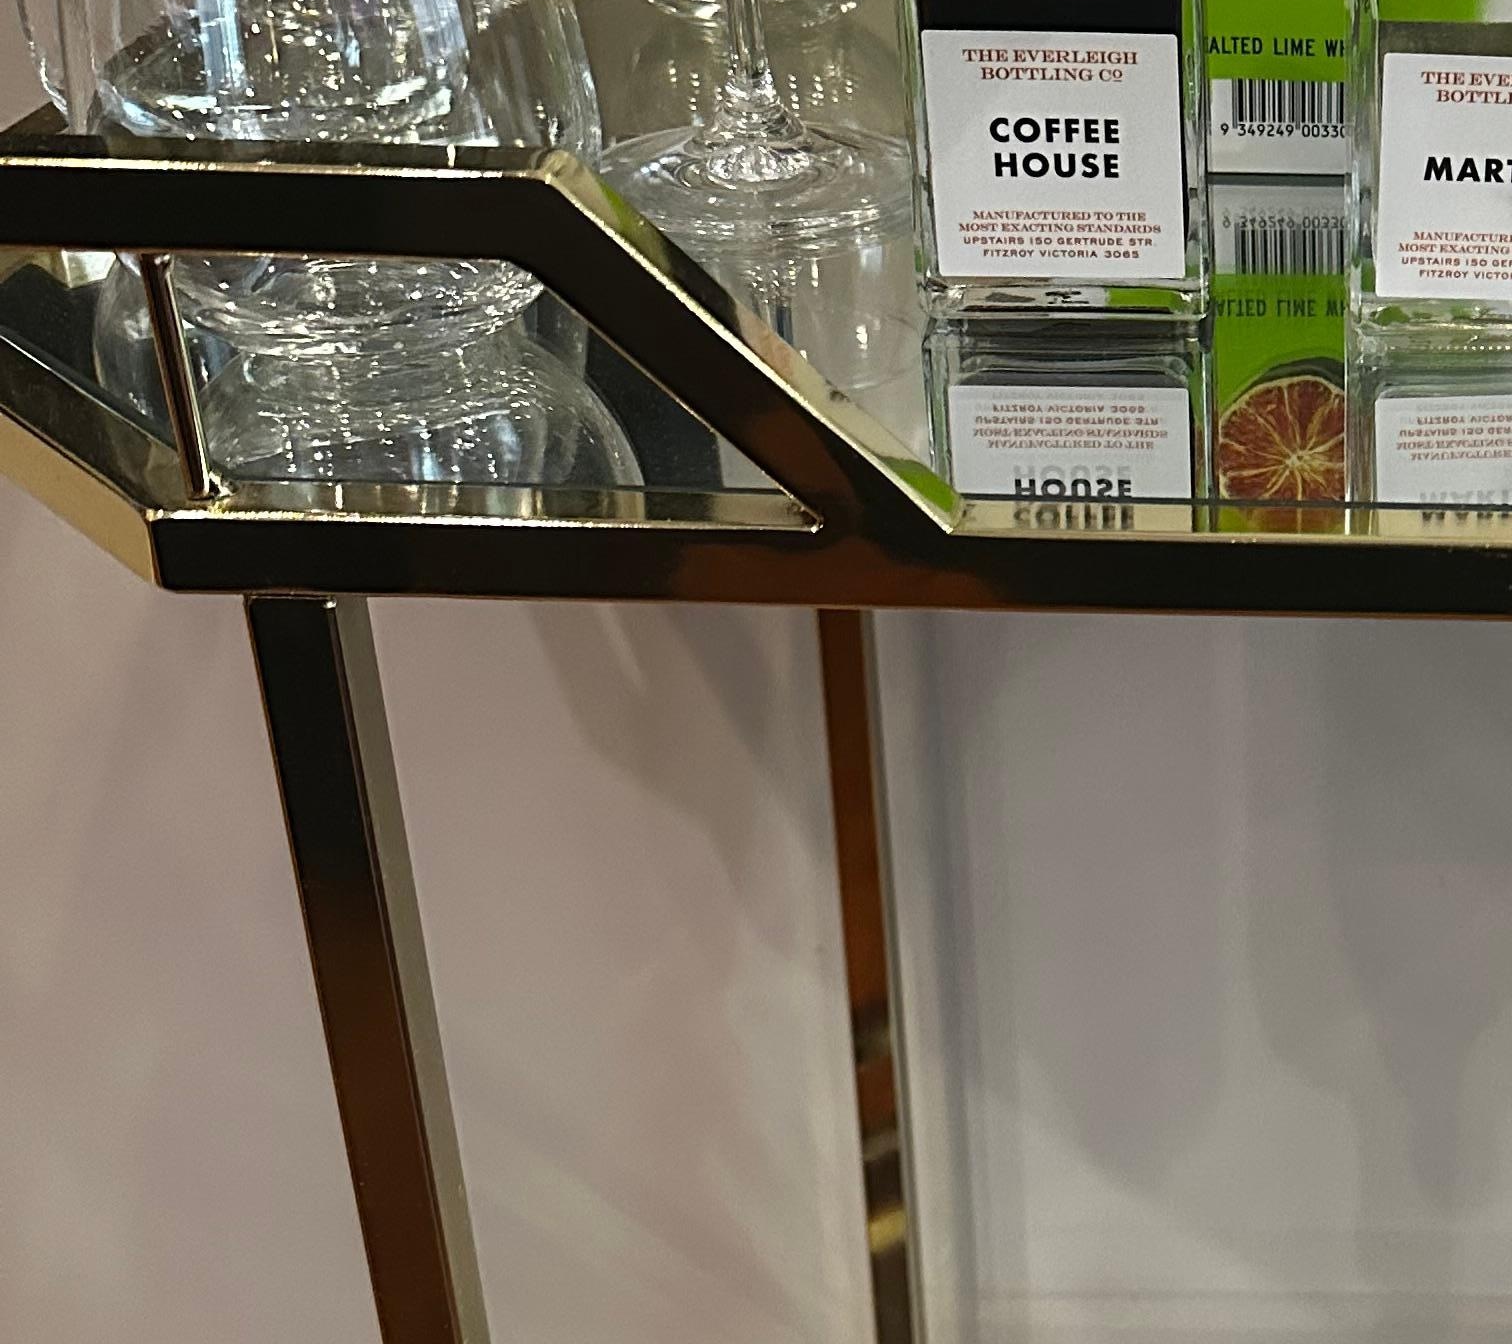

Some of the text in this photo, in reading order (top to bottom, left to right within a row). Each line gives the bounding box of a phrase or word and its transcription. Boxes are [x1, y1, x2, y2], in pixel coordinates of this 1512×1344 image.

[1273, 38, 1316, 57] LIME
[962, 49, 1138, 65] THE EVERLEIGH
[981, 67, 1093, 82] BOTTLING
[1421, 71, 1465, 86] THE
[989, 117, 1120, 144] COFFEE
[1220, 123, 1229, 136] 9
[1237, 123, 1294, 137] 349249
[994, 152, 1120, 178] HOUSE
[973, 210, 1146, 222] MANUFACTURED TO THE
[959, 223, 1161, 234] MOST EXACTING STANDARDS
[963, 236, 1024, 245] UPSTAIRS
[1030, 236, 1052, 245] 150
[1057, 237, 1123, 246] GERTRUDE
[983, 248, 1140, 259] FITZROY VICTORIA 3065
[1398, 242, 1436, 252] MOST
[1440, 244, 1510, 255] EXACTING
[1401, 257, 1460, 267] UPSTAIRS
[1465, 259, 1487, 267] 150
[1419, 269, 1468, 279] FITZROY
